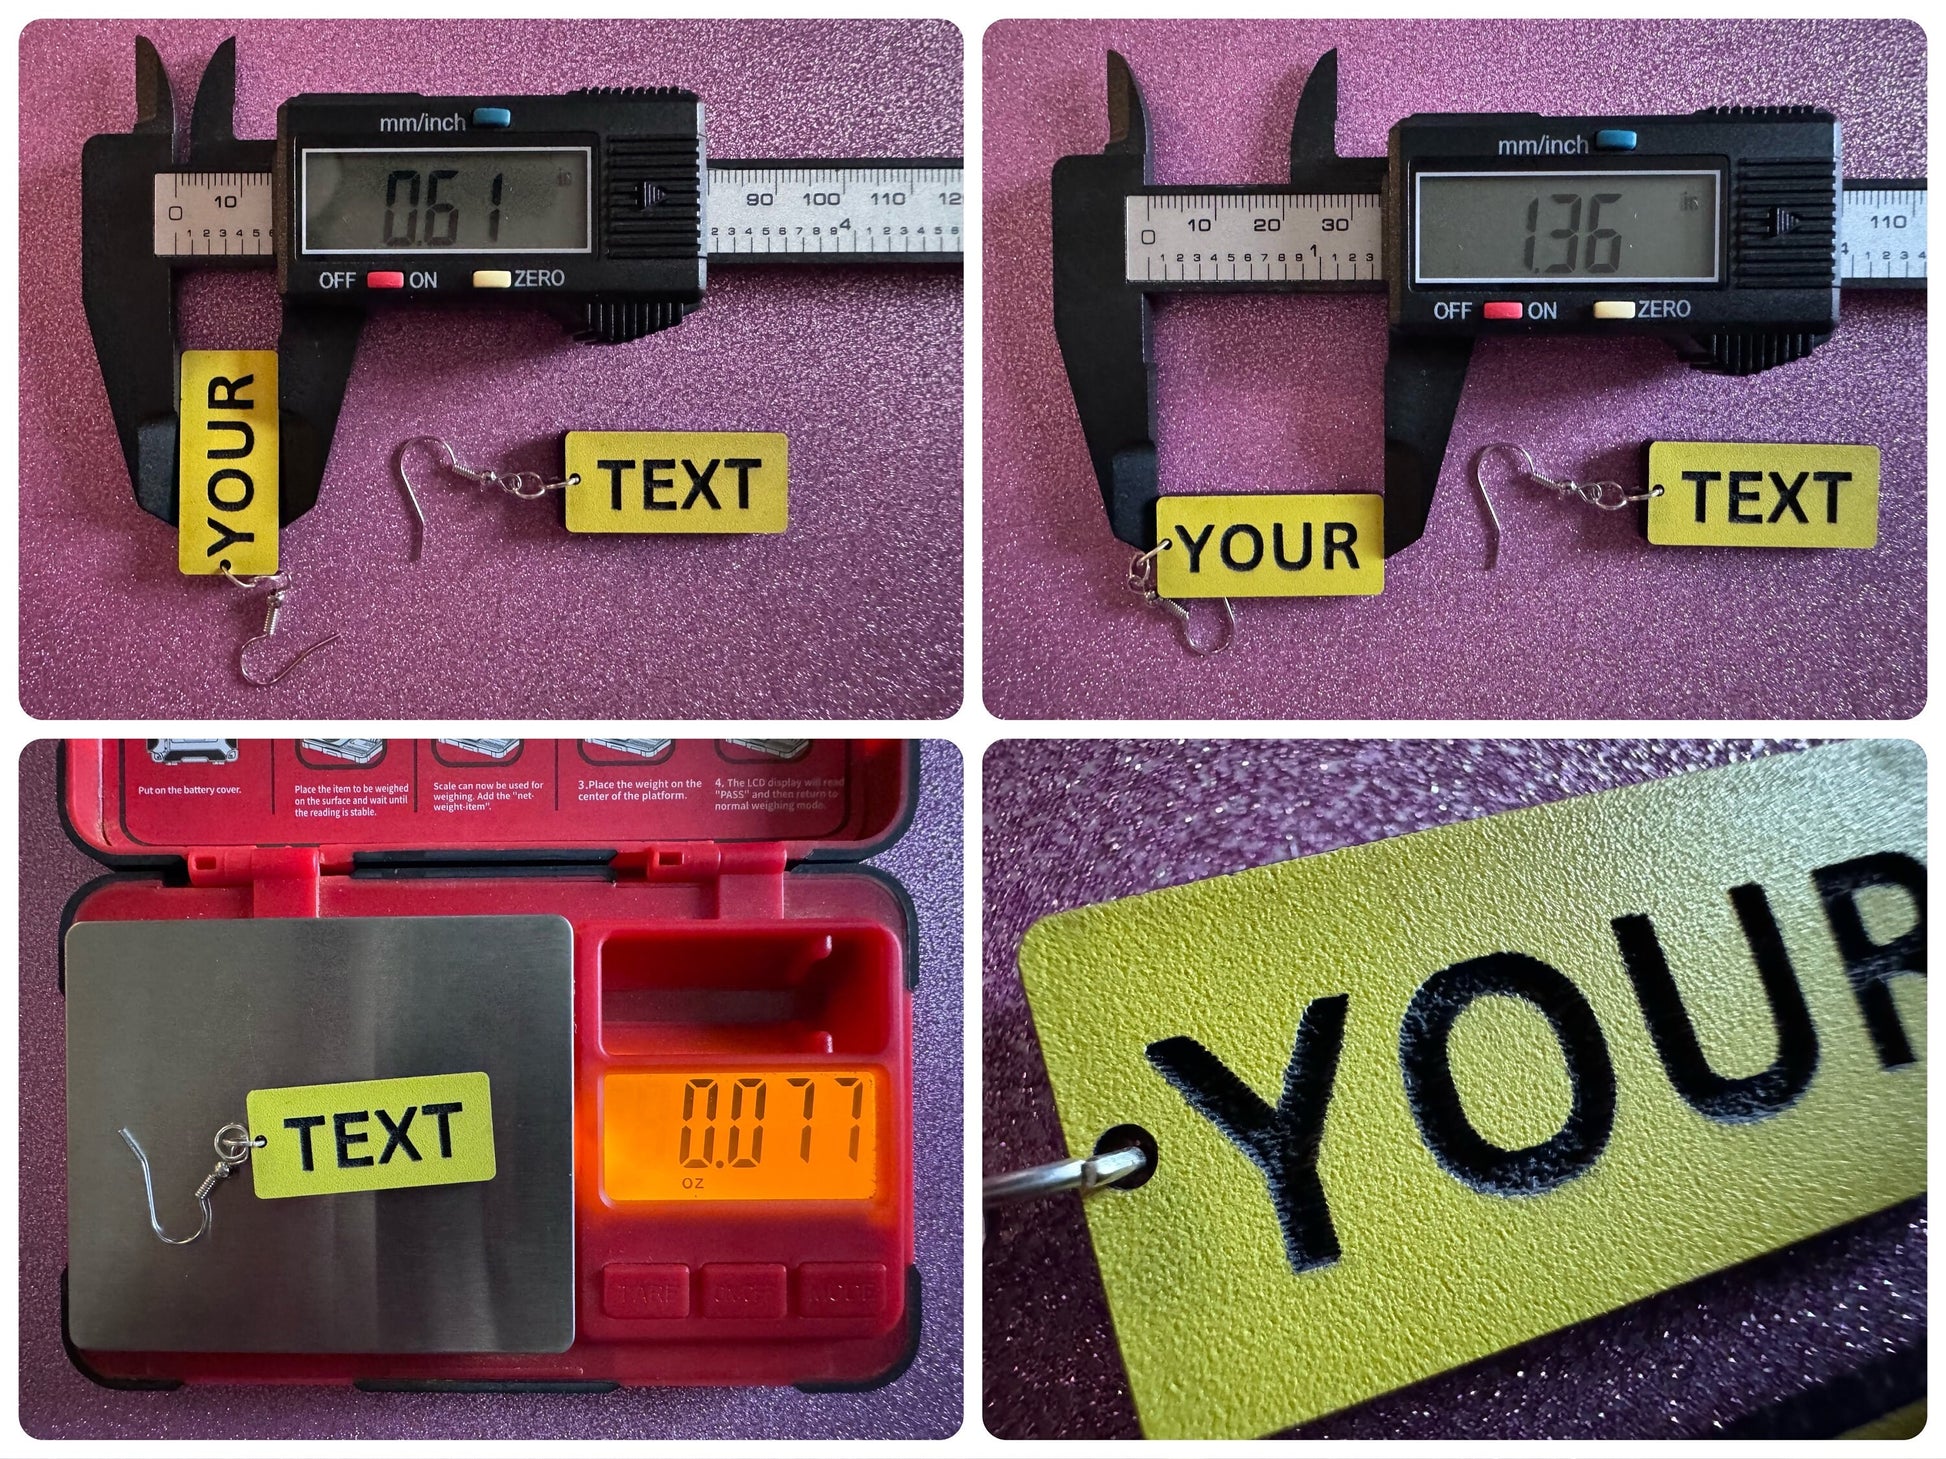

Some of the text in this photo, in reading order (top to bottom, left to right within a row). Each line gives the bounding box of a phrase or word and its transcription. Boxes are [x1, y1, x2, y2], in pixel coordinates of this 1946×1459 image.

[380, 113, 466, 132] mm/inch
[1499, 135, 1589, 156] mm/inch
[214, 196, 237, 208] 10
[746, 192, 963, 206] 90 100 110 12
[168, 205, 183, 221] 0
[383, 170, 503, 246] 0.61
[711, 227, 719, 235] 2
[728, 227, 736, 235] 3
[745, 227, 752, 235] 4
[762, 227, 770, 235] 5
[779, 227, 787, 235] 6
[795, 227, 803, 235] 7
[813, 227, 821, 235] 8
[839, 218, 851, 230] 4
[866, 226, 872, 235] 1
[883, 226, 891, 235] 2
[900, 226, 908, 235] 3
[917, 226, 925, 235] 4
[934, 226, 943, 235] 5
[1187, 218, 1350, 232] 10 20 30
[1870, 215, 1907, 229] 110
[187, 229, 192, 237] 1
[203, 229, 211, 237] 2
[219, 229, 227, 237] 3
[236, 229, 243, 237] 4
[252, 229, 260, 237] 5
[1141, 229, 1156, 245] 0
[1524, 193, 1622, 274] 1.36
[1160, 244, 1374, 262] 1 2 3 4 5 6 7 8 9 1 1 2 3
[1865, 251, 1871, 260] 1
[1882, 251, 1892, 260] 2
[1899, 251, 1909, 260] 3
[1918, 251, 1927, 260] 4
[319, 271, 357, 289] OFF
[409, 271, 438, 289] ON
[514, 269, 566, 287] ZERO
[1433, 302, 1473, 320] OFF
[1527, 301, 1558, 320] ON
[1637, 300, 1692, 319] ZERO
[207, 374, 255, 557] YOUR
[597, 458, 762, 511] TEXT
[1681, 470, 1853, 524] TEXT
[1174, 522, 1361, 574] YOUR
[138, 786, 154, 795] Put
[167, 786, 183, 795] the
[183, 785, 215, 796] battery
[216, 786, 242, 794] cover.
[294, 783, 409, 795] Place the item to be weighed
[433, 781, 457, 791] Scale
[457, 783, 474, 791] can
[495, 781, 507, 790] be
[508, 781, 530, 790] used
[531, 780, 544, 789] for
[577, 780, 615, 790] 3.Place
[616, 779, 633, 789] the
[634, 778, 669, 791] weight
[685, 779, 703, 788] the
[727, 778, 745, 788] The
[747, 778, 766, 788] LCD
[767, 777, 802, 789] display
[294, 795, 408, 806] on the surface and wait until
[433, 792, 475, 803] weighing.
[476, 792, 495, 800] Add
[496, 792, 511, 800] the
[577, 790, 688, 802] center of the platform.
[751, 789, 770, 799] and
[772, 789, 794, 799] then
[295, 807, 377, 819] the reading is stable.
[715, 801, 749, 811] normal
[751, 801, 796, 813] weighing
[1146, 851, 1927, 1275] YOUR
[679, 1077, 864, 1168] 0.077
[283, 1102, 463, 1172] TEXT
